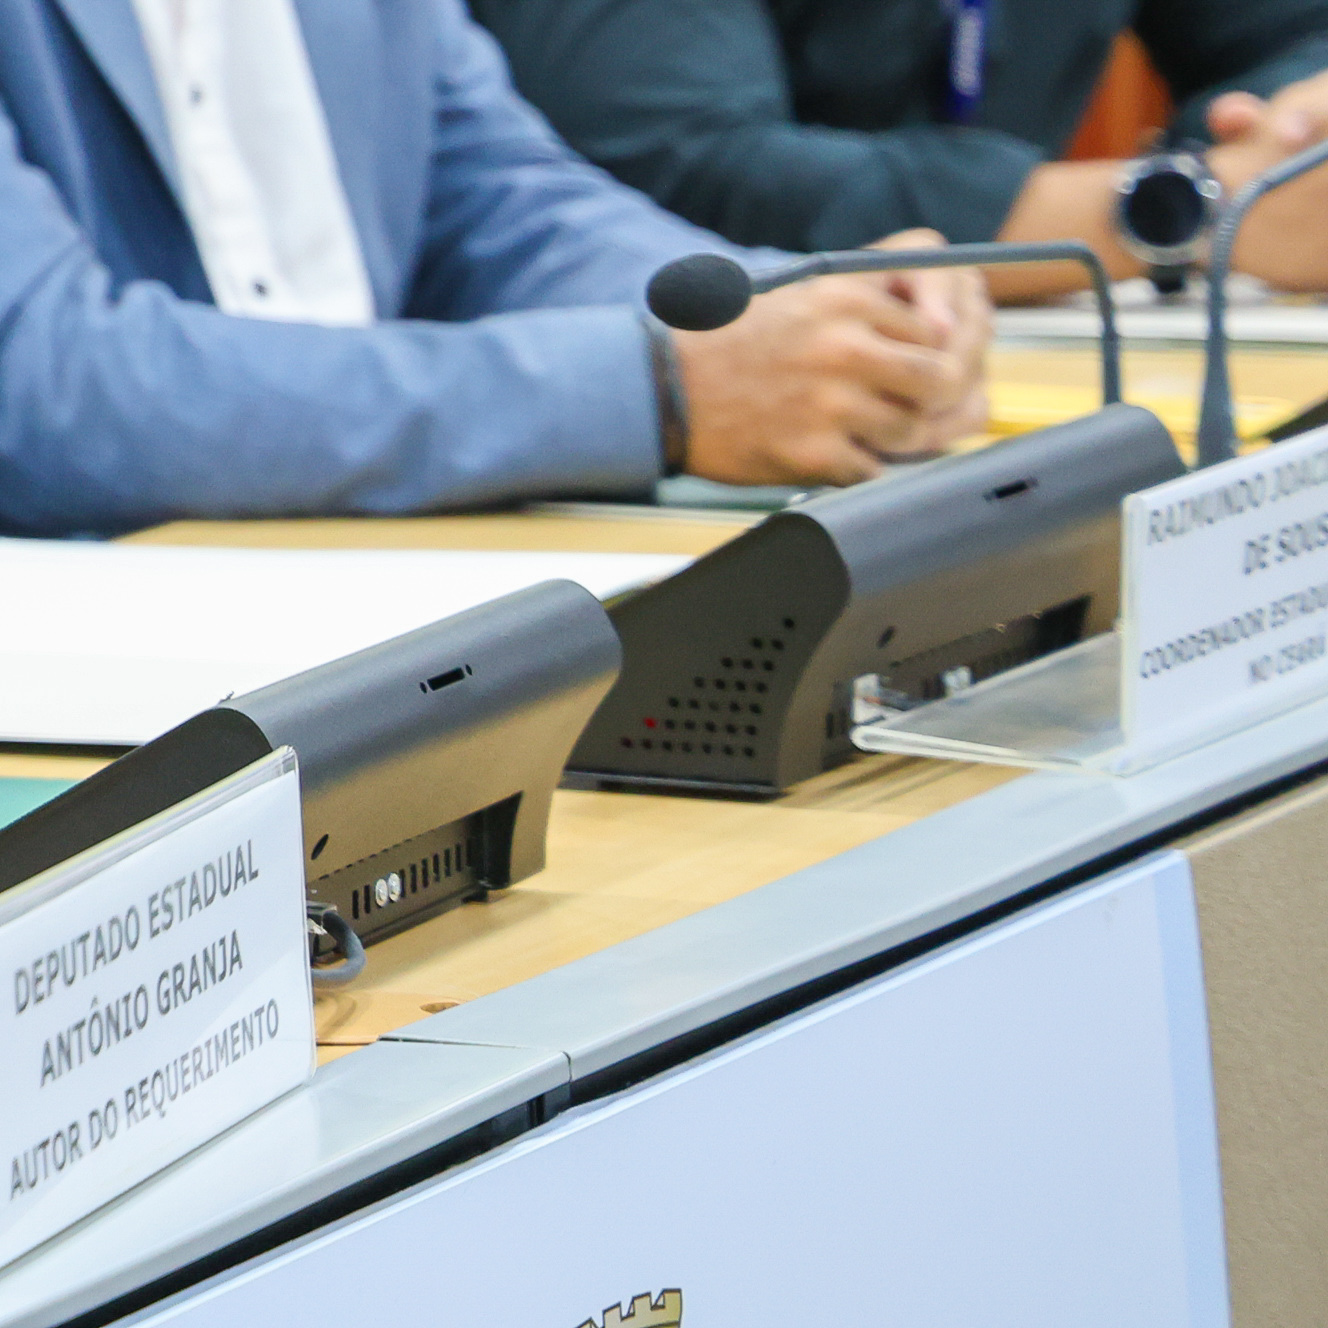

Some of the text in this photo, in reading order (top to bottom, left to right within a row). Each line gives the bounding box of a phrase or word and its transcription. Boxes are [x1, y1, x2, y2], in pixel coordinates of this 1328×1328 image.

[1243, 534, 1269, 575] DE
[14, 838, 259, 1015] DEPUTADO ESTADUAL
[41, 929, 244, 1088] ANTÔNIO GRANJA
[10, 998, 280, 1200] AUTOR DO REQUERIMENTO
